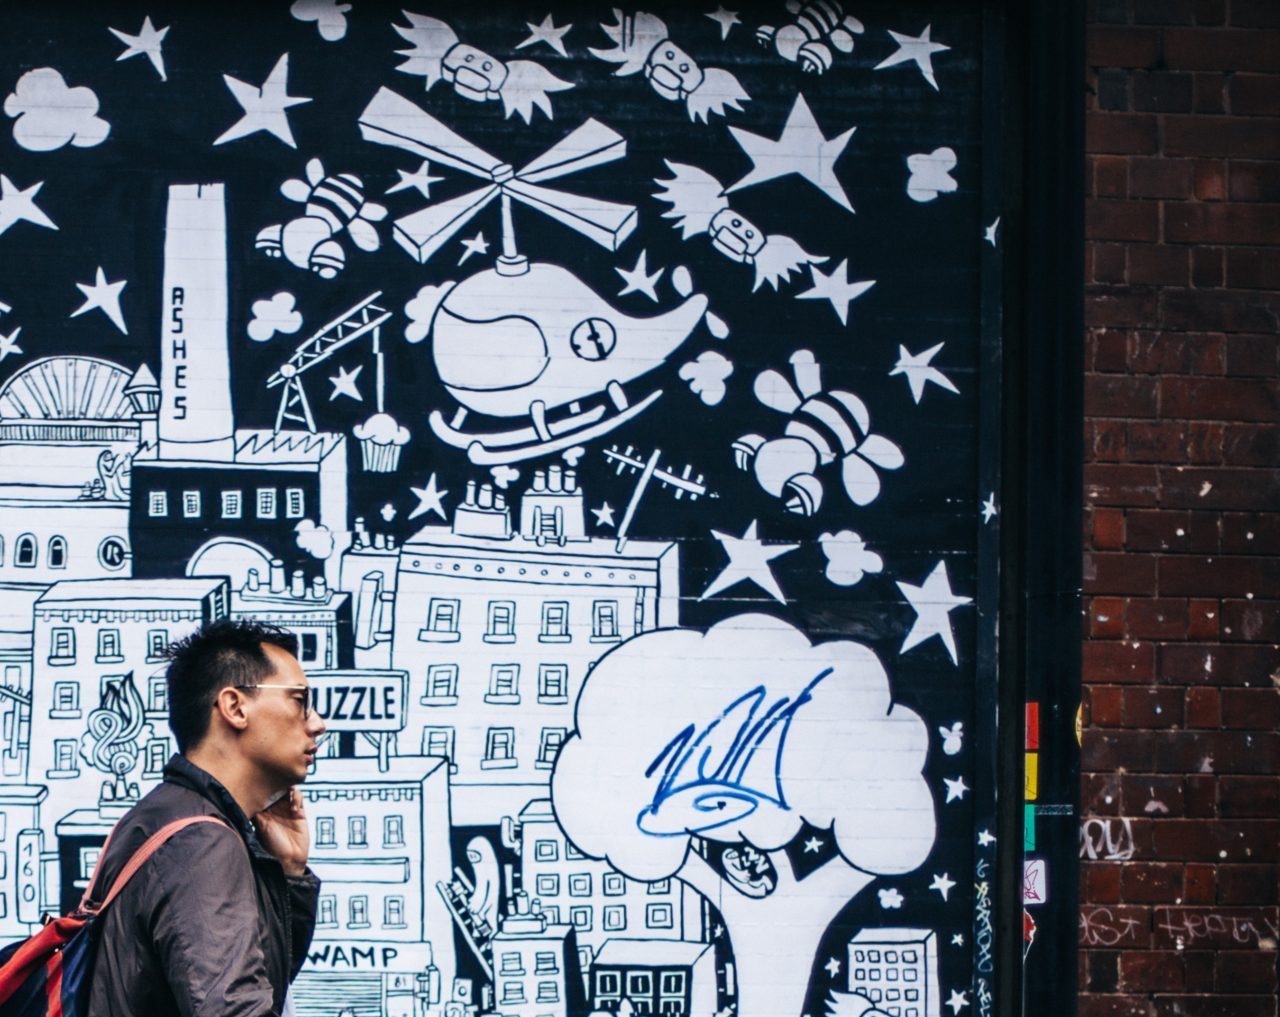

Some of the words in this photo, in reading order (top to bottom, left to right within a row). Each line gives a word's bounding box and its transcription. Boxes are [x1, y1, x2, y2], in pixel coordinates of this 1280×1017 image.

[171, 286, 187, 420] ASHES
[312, 686, 396, 720] UZZLE
[23, 842, 36, 902] 160
[307, 944, 398, 968] WAMP
